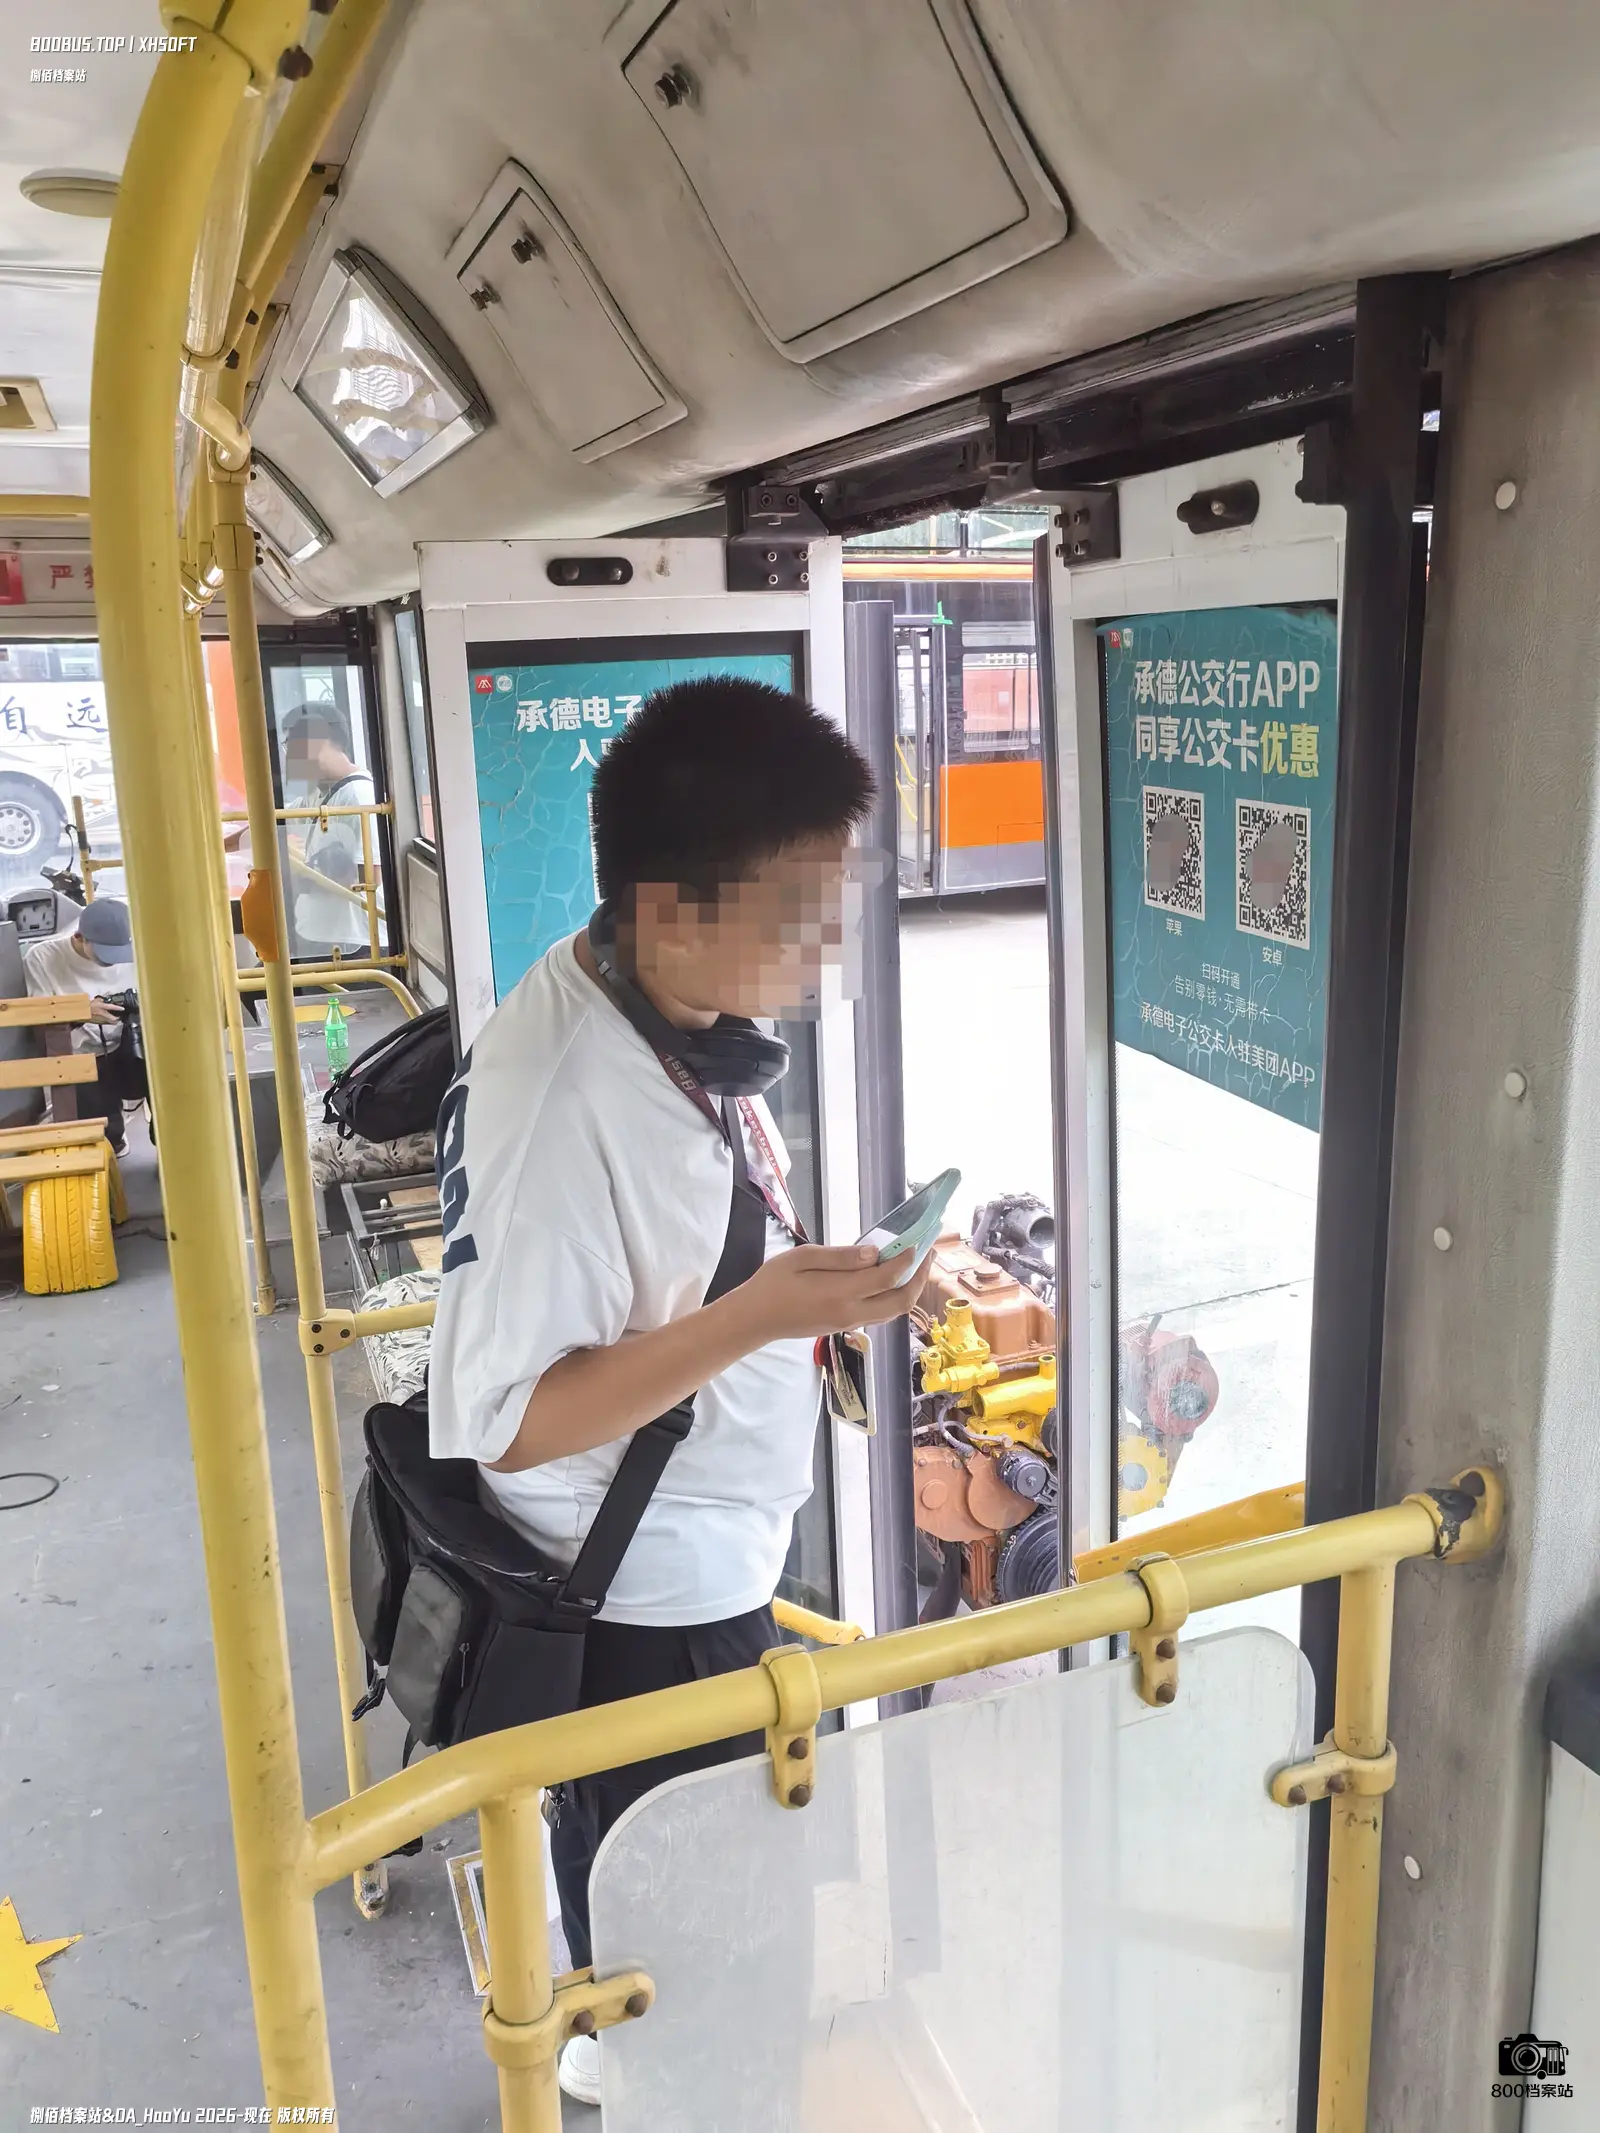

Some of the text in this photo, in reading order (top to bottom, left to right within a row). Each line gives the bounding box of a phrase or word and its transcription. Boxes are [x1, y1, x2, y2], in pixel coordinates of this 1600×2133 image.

[1134, 658, 1321, 709] 承德公交行APP
[1135, 715, 1320, 778] 同享公交卡优惠
[1165, 918, 1183, 936] 苹果
[1262, 945, 1283, 967] 安卓
[1201, 963, 1241, 990] 扫码开通
